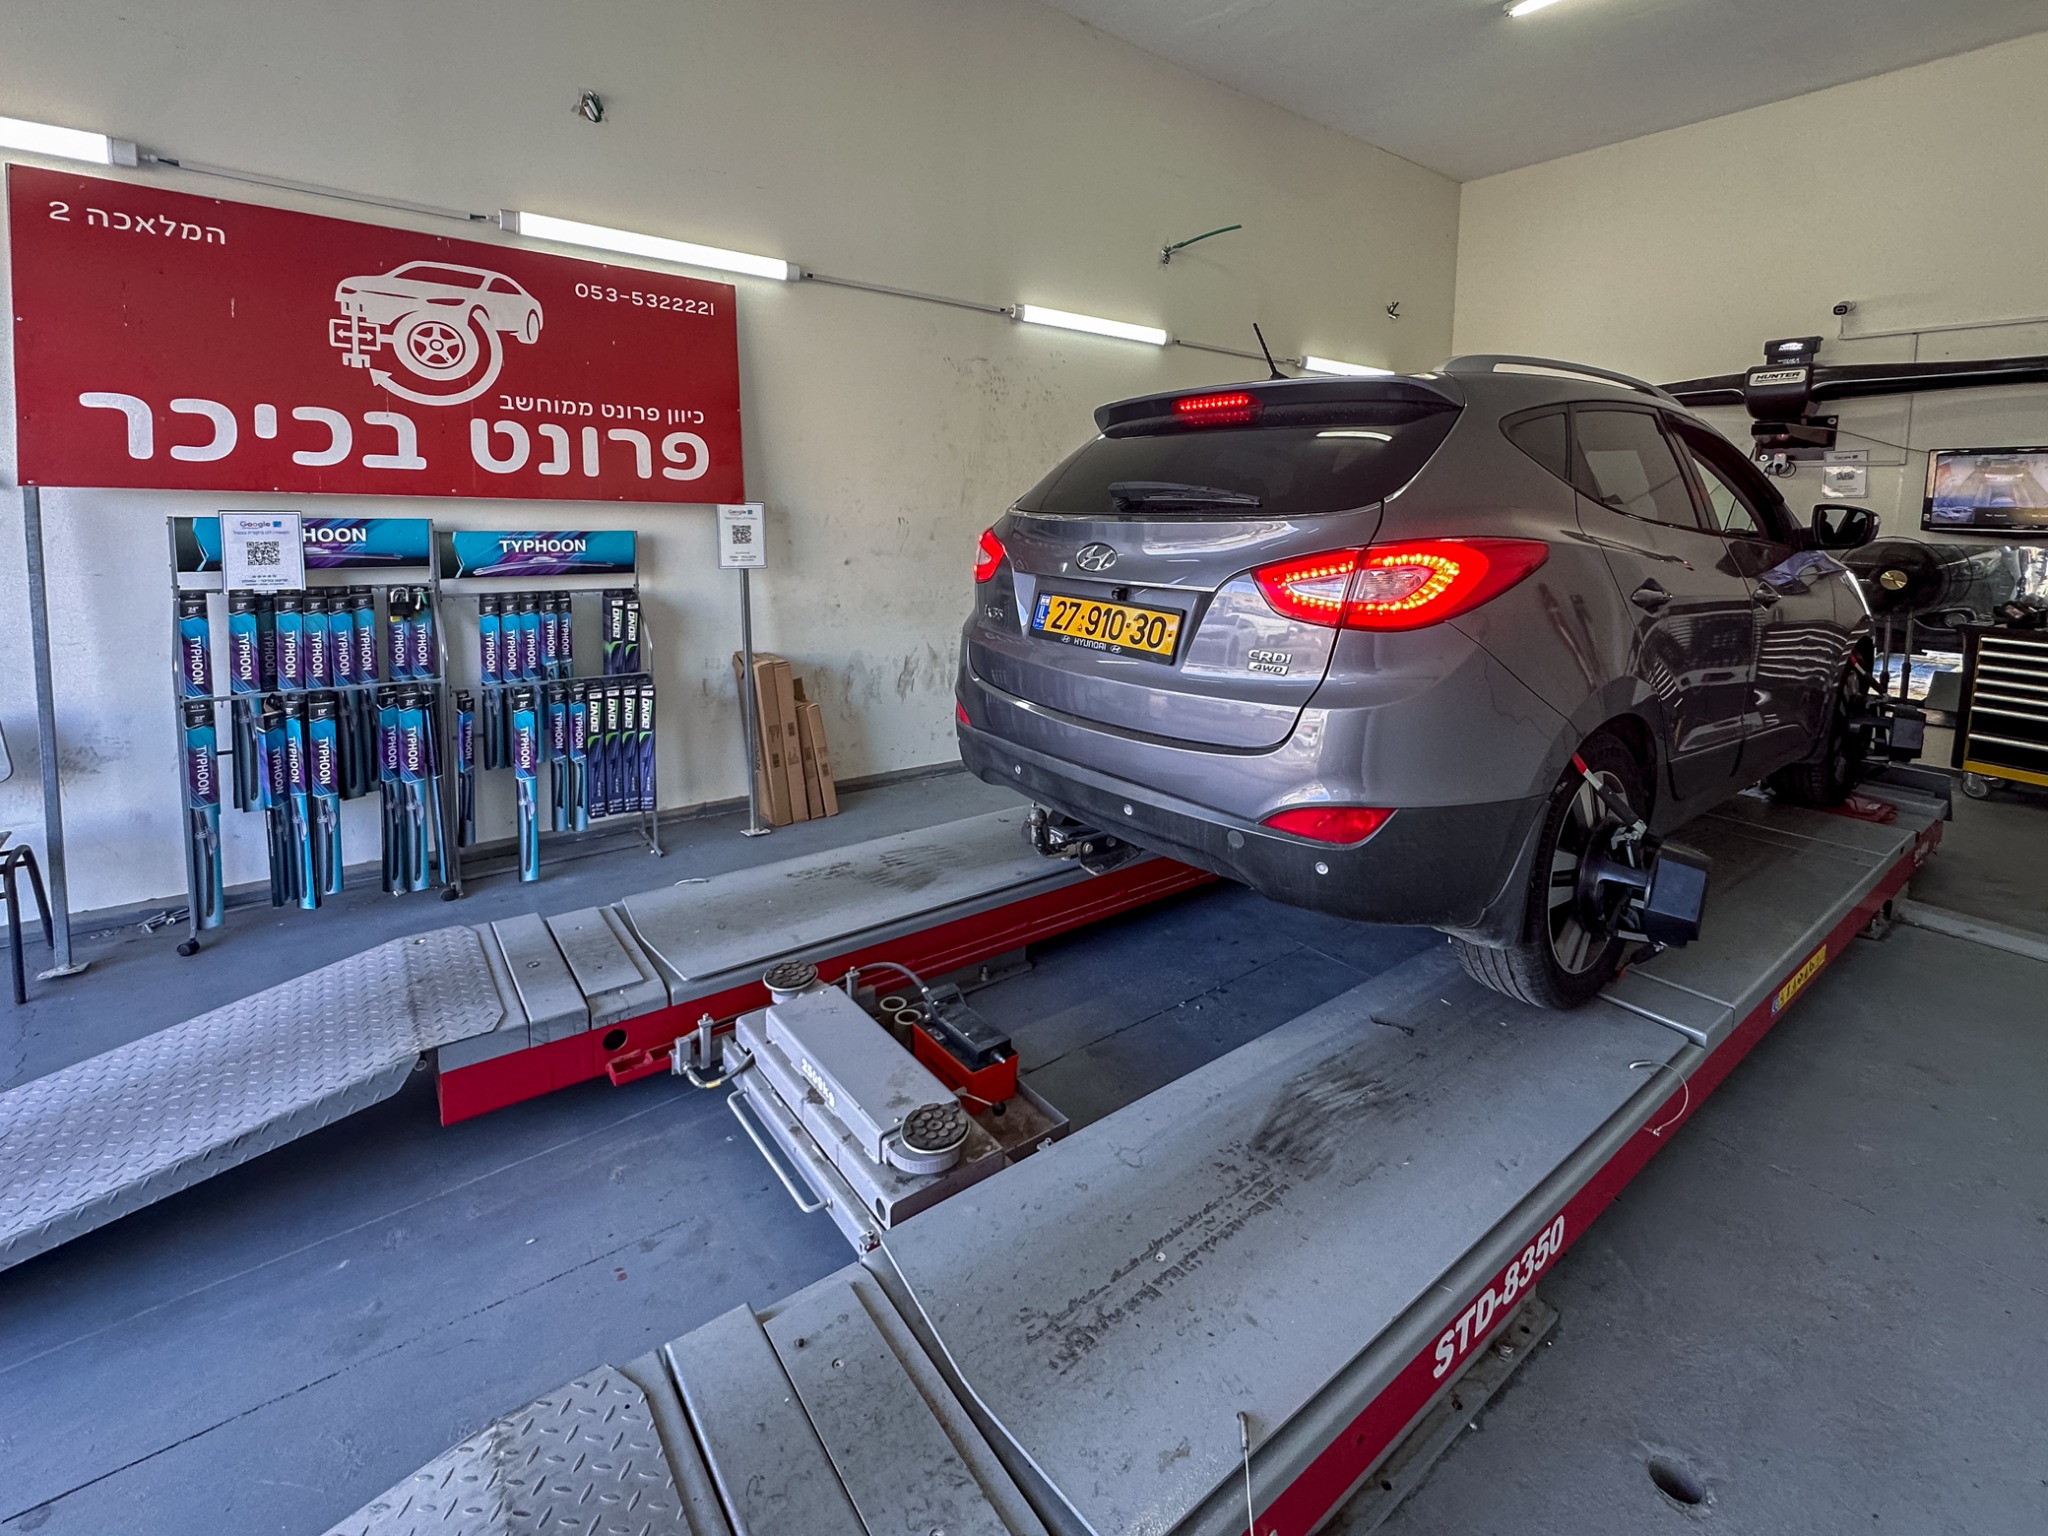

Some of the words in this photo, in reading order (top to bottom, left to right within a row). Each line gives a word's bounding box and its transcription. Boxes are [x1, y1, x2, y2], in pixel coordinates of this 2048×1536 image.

[49, 201, 71, 221] 2
[86, 207, 226, 245] המלאכה
[574, 282, 715, 316] 053-5322221
[1756, 371, 1801, 380] HUNTER
[499, 394, 594, 417] ממוחשב
[601, 402, 660, 422] פרונט
[667, 408, 704, 425] כיוון
[78, 392, 427, 470] בכיכר
[470, 418, 710, 481] פרונט
[240, 521, 271, 529] Google
[302, 527, 367, 543] HOON
[499, 539, 587, 553] TYPHOON
[238, 631, 253, 680] TYPHOON
[284, 630, 296, 678] TYPHOON
[311, 630, 323, 677] TYPHOON
[337, 629, 350, 676] TYPHOON
[360, 626, 372, 671] TYPHOON
[394, 623, 405, 667] TYPHOON
[416, 622, 428, 666] TYPHOON
[485, 630, 496, 673] TYPHOON
[506, 629, 517, 671] TYPHOON
[526, 628, 537, 669] TYPHOON
[546, 619, 556, 657] TYPHOON
[561, 618, 570, 656] TYPHOON
[1073, 637, 1107, 651] HYUNDAI
[190, 635, 205, 685] TYPHOON
[1253, 664, 1284, 673] 4WD
[387, 723, 398, 770] TYPHOON
[407, 725, 419, 771] TYPHOON
[520, 726, 531, 769] TYPHOON
[554, 711, 563, 749] TYPHOON
[575, 711, 584, 749] TYPHOON
[195, 745, 210, 796] TYPHOON
[272, 746, 284, 795] TYPHOON
[287, 736, 300, 784] TYPHOON
[318, 736, 331, 785] TYPHOON
[1433, 1214, 1565, 1379] STD-8350
